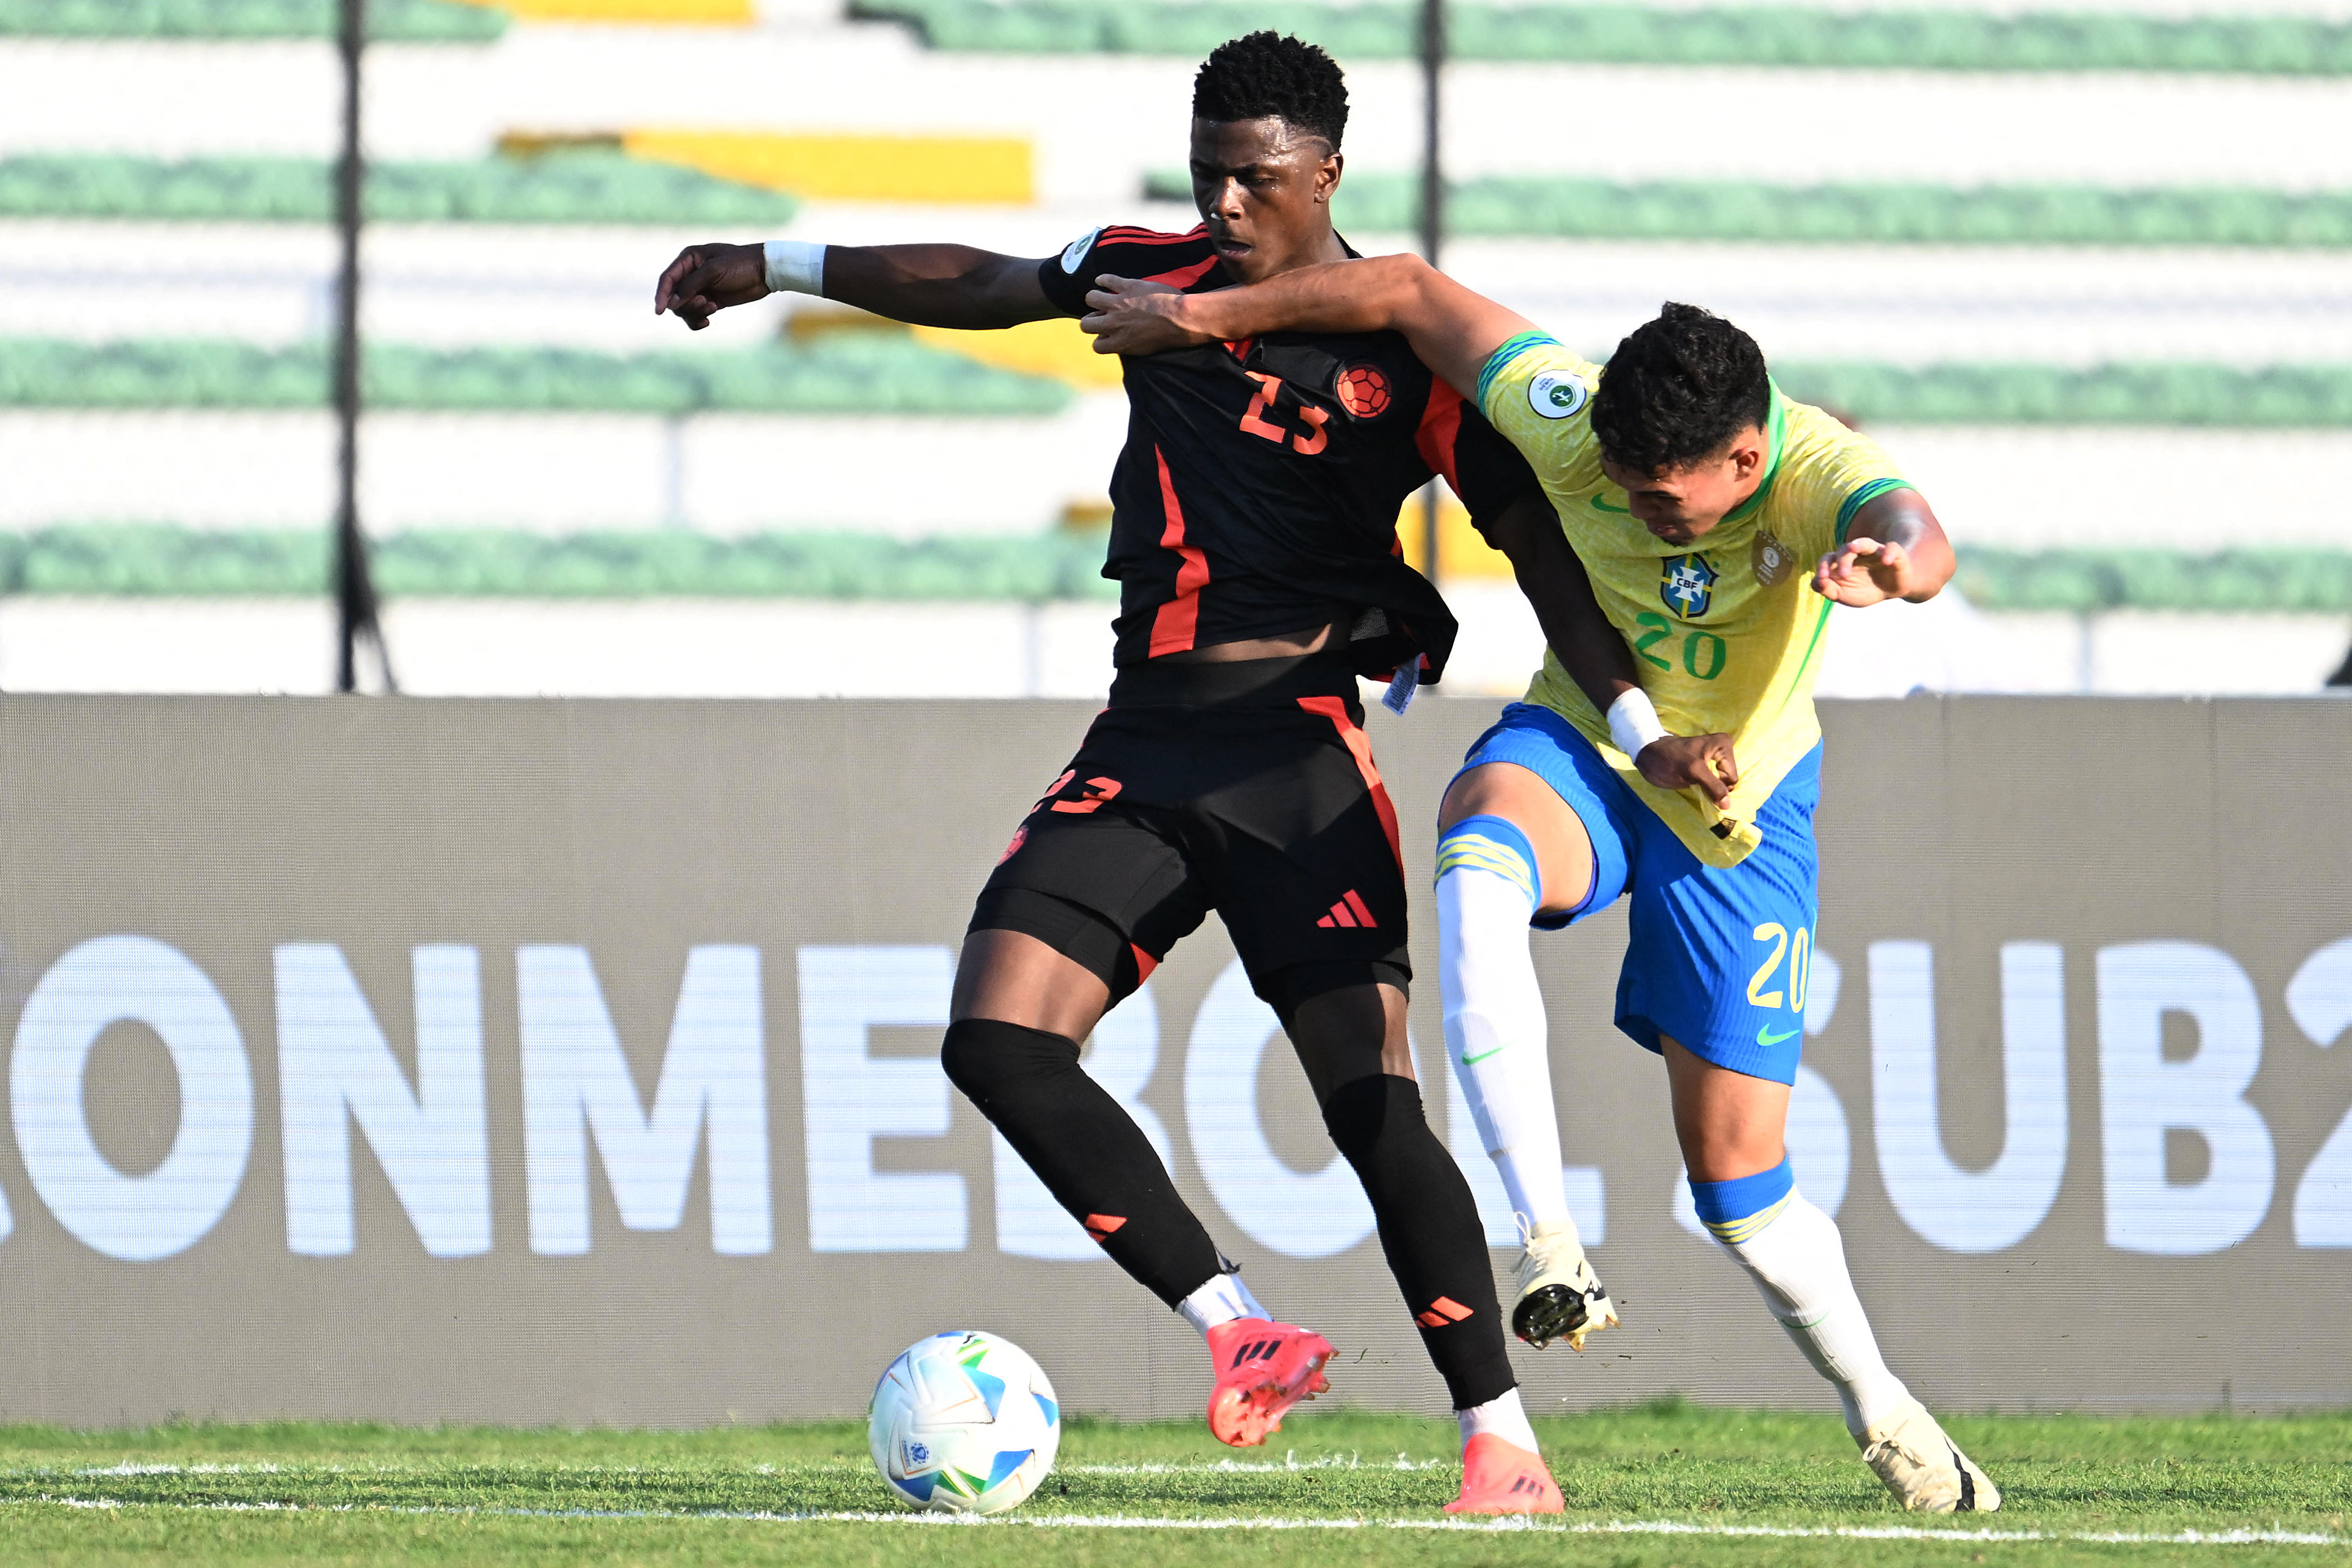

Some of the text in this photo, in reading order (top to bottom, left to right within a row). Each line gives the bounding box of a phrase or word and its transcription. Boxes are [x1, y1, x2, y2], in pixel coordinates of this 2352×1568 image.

[1239, 371, 1329, 455] 23
[1677, 578, 1698, 590] CBF
[1636, 612, 1726, 680] 20
[1747, 922, 1809, 1013] 20
[0, 934, 1604, 1261] ONMEO
